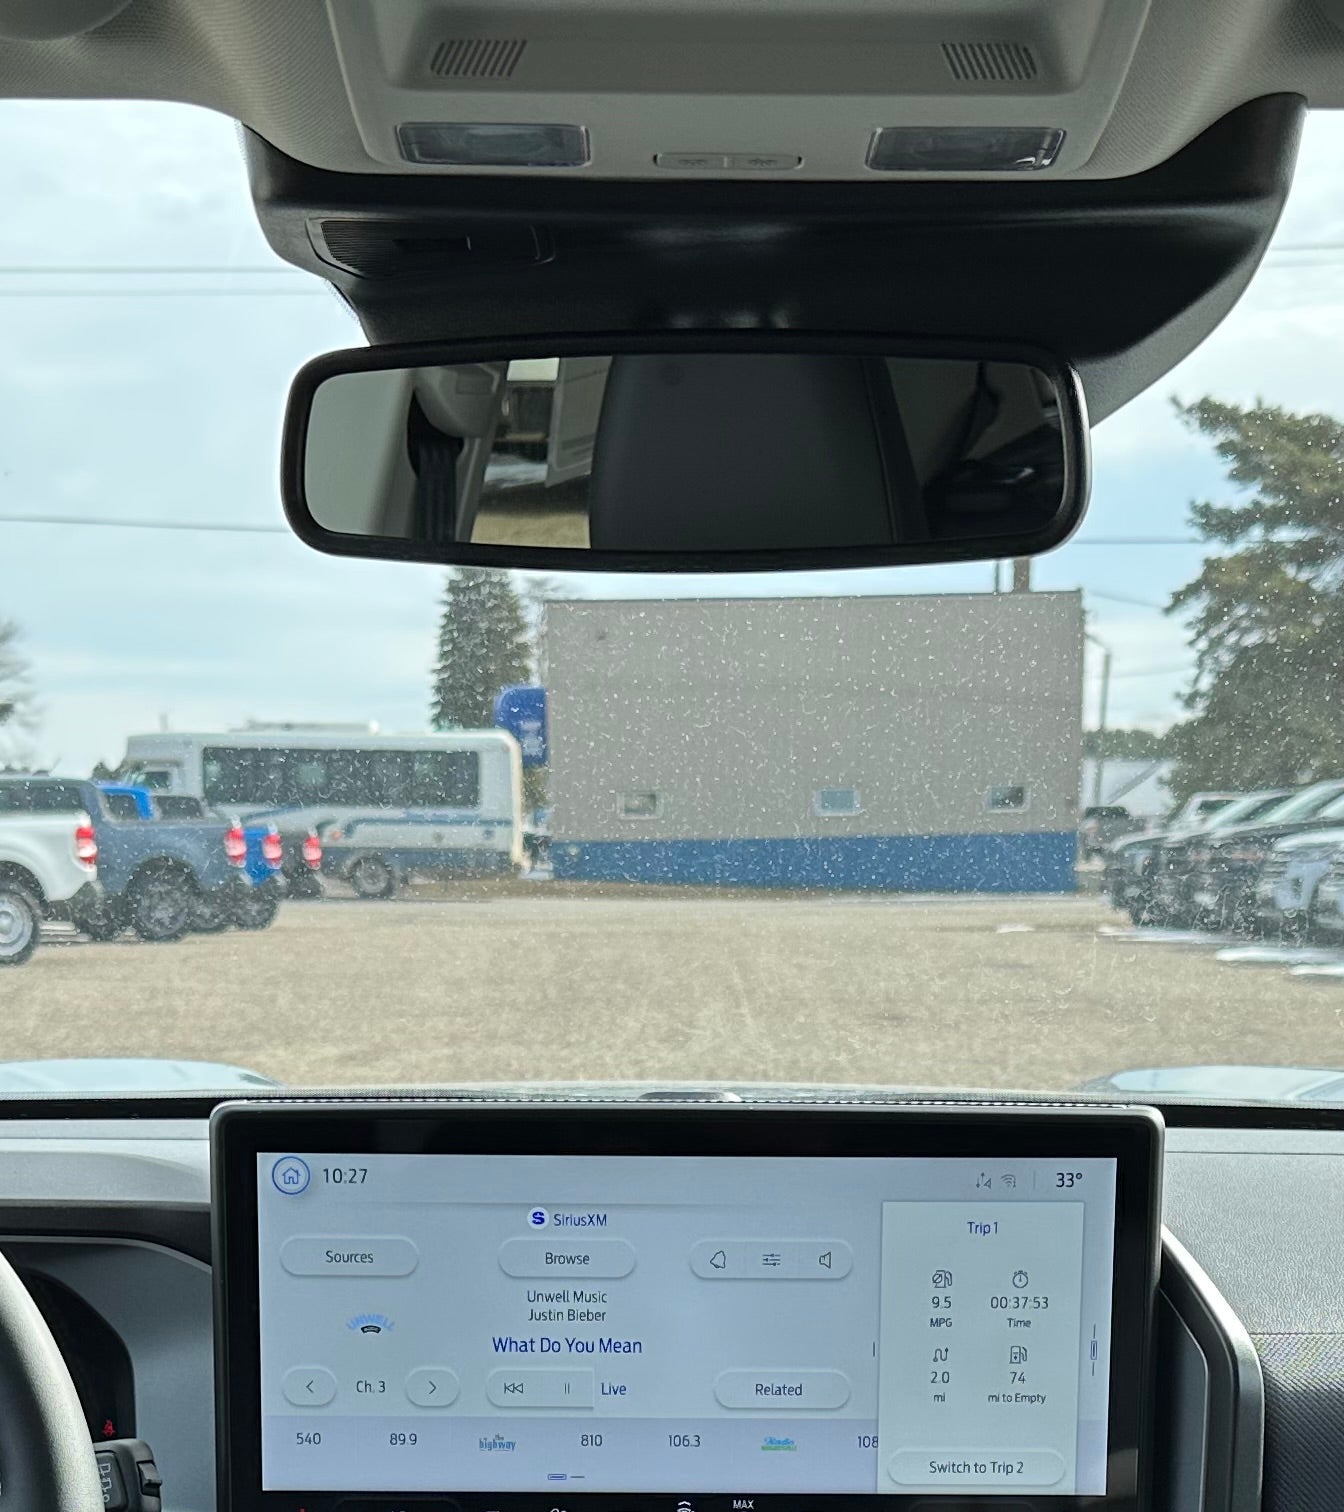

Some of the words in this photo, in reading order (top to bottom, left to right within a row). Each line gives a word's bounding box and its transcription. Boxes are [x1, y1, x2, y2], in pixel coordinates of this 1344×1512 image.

[322, 1167, 368, 1185] 10:27
[553, 1213, 607, 1226] SiriusXM
[967, 1222, 992, 1235] Trip
[994, 1222, 998, 1234] 1
[325, 1250, 374, 1265] Sources
[545, 1252, 590, 1265] Browse
[527, 1289, 570, 1304] Unwell
[573, 1289, 608, 1304] Music
[931, 1296, 952, 1310] 9.5
[990, 1296, 1050, 1310] 00:37:53
[528, 1308, 564, 1323] Justin
[567, 1308, 606, 1322] Bieber
[929, 1317, 953, 1328] MPG
[1007, 1317, 1032, 1329] Time
[492, 1337, 535, 1354] What
[539, 1337, 561, 1354] Do
[565, 1337, 595, 1354] You
[599, 1338, 643, 1354] Mean
[930, 1371, 950, 1385] 2.0
[1009, 1371, 1026, 1385] 74
[355, 1379, 375, 1394] Ch.
[378, 1380, 386, 1394] 3
[600, 1382, 628, 1397] Live
[755, 1382, 803, 1397] Related
[933, 1392, 946, 1404] mi
[988, 1392, 999, 1404] mi
[1001, 1392, 1011, 1404] to
[1013, 1392, 1046, 1406] Empty
[296, 1432, 322, 1447] 540
[389, 1432, 418, 1447] 89.9
[580, 1434, 603, 1448] 810
[667, 1434, 701, 1448] 106.3
[929, 1460, 971, 1475] Switch
[974, 1461, 986, 1475] to
[989, 1461, 1013, 1476] Trip
[1016, 1461, 1024, 1475] 2
[733, 1500, 755, 1510] MAX
